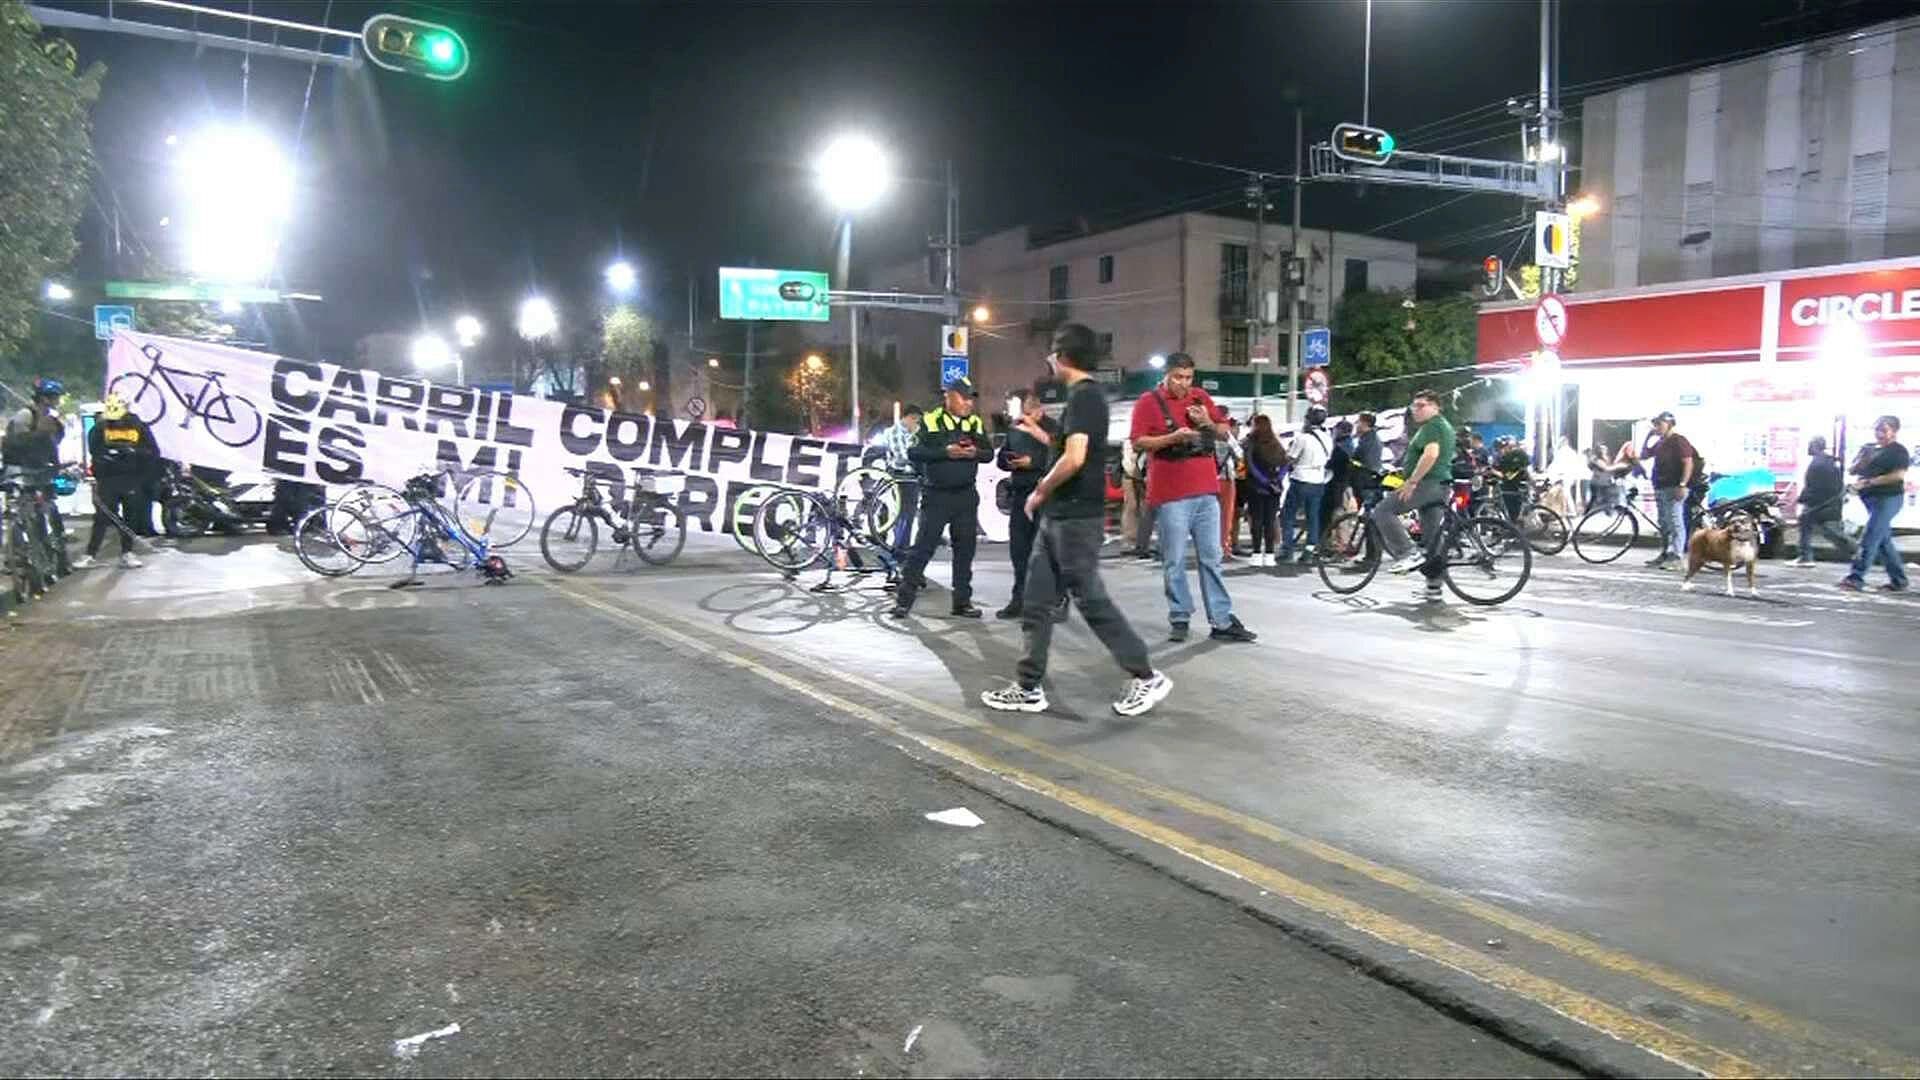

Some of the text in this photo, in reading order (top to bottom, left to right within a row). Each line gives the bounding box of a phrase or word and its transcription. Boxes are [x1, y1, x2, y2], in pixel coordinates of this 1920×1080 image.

[1791, 289, 1920, 328] CIRCLE
[271, 358, 534, 448] CARRIL
[262, 411, 367, 485] ES
[433, 439, 522, 508] MI
